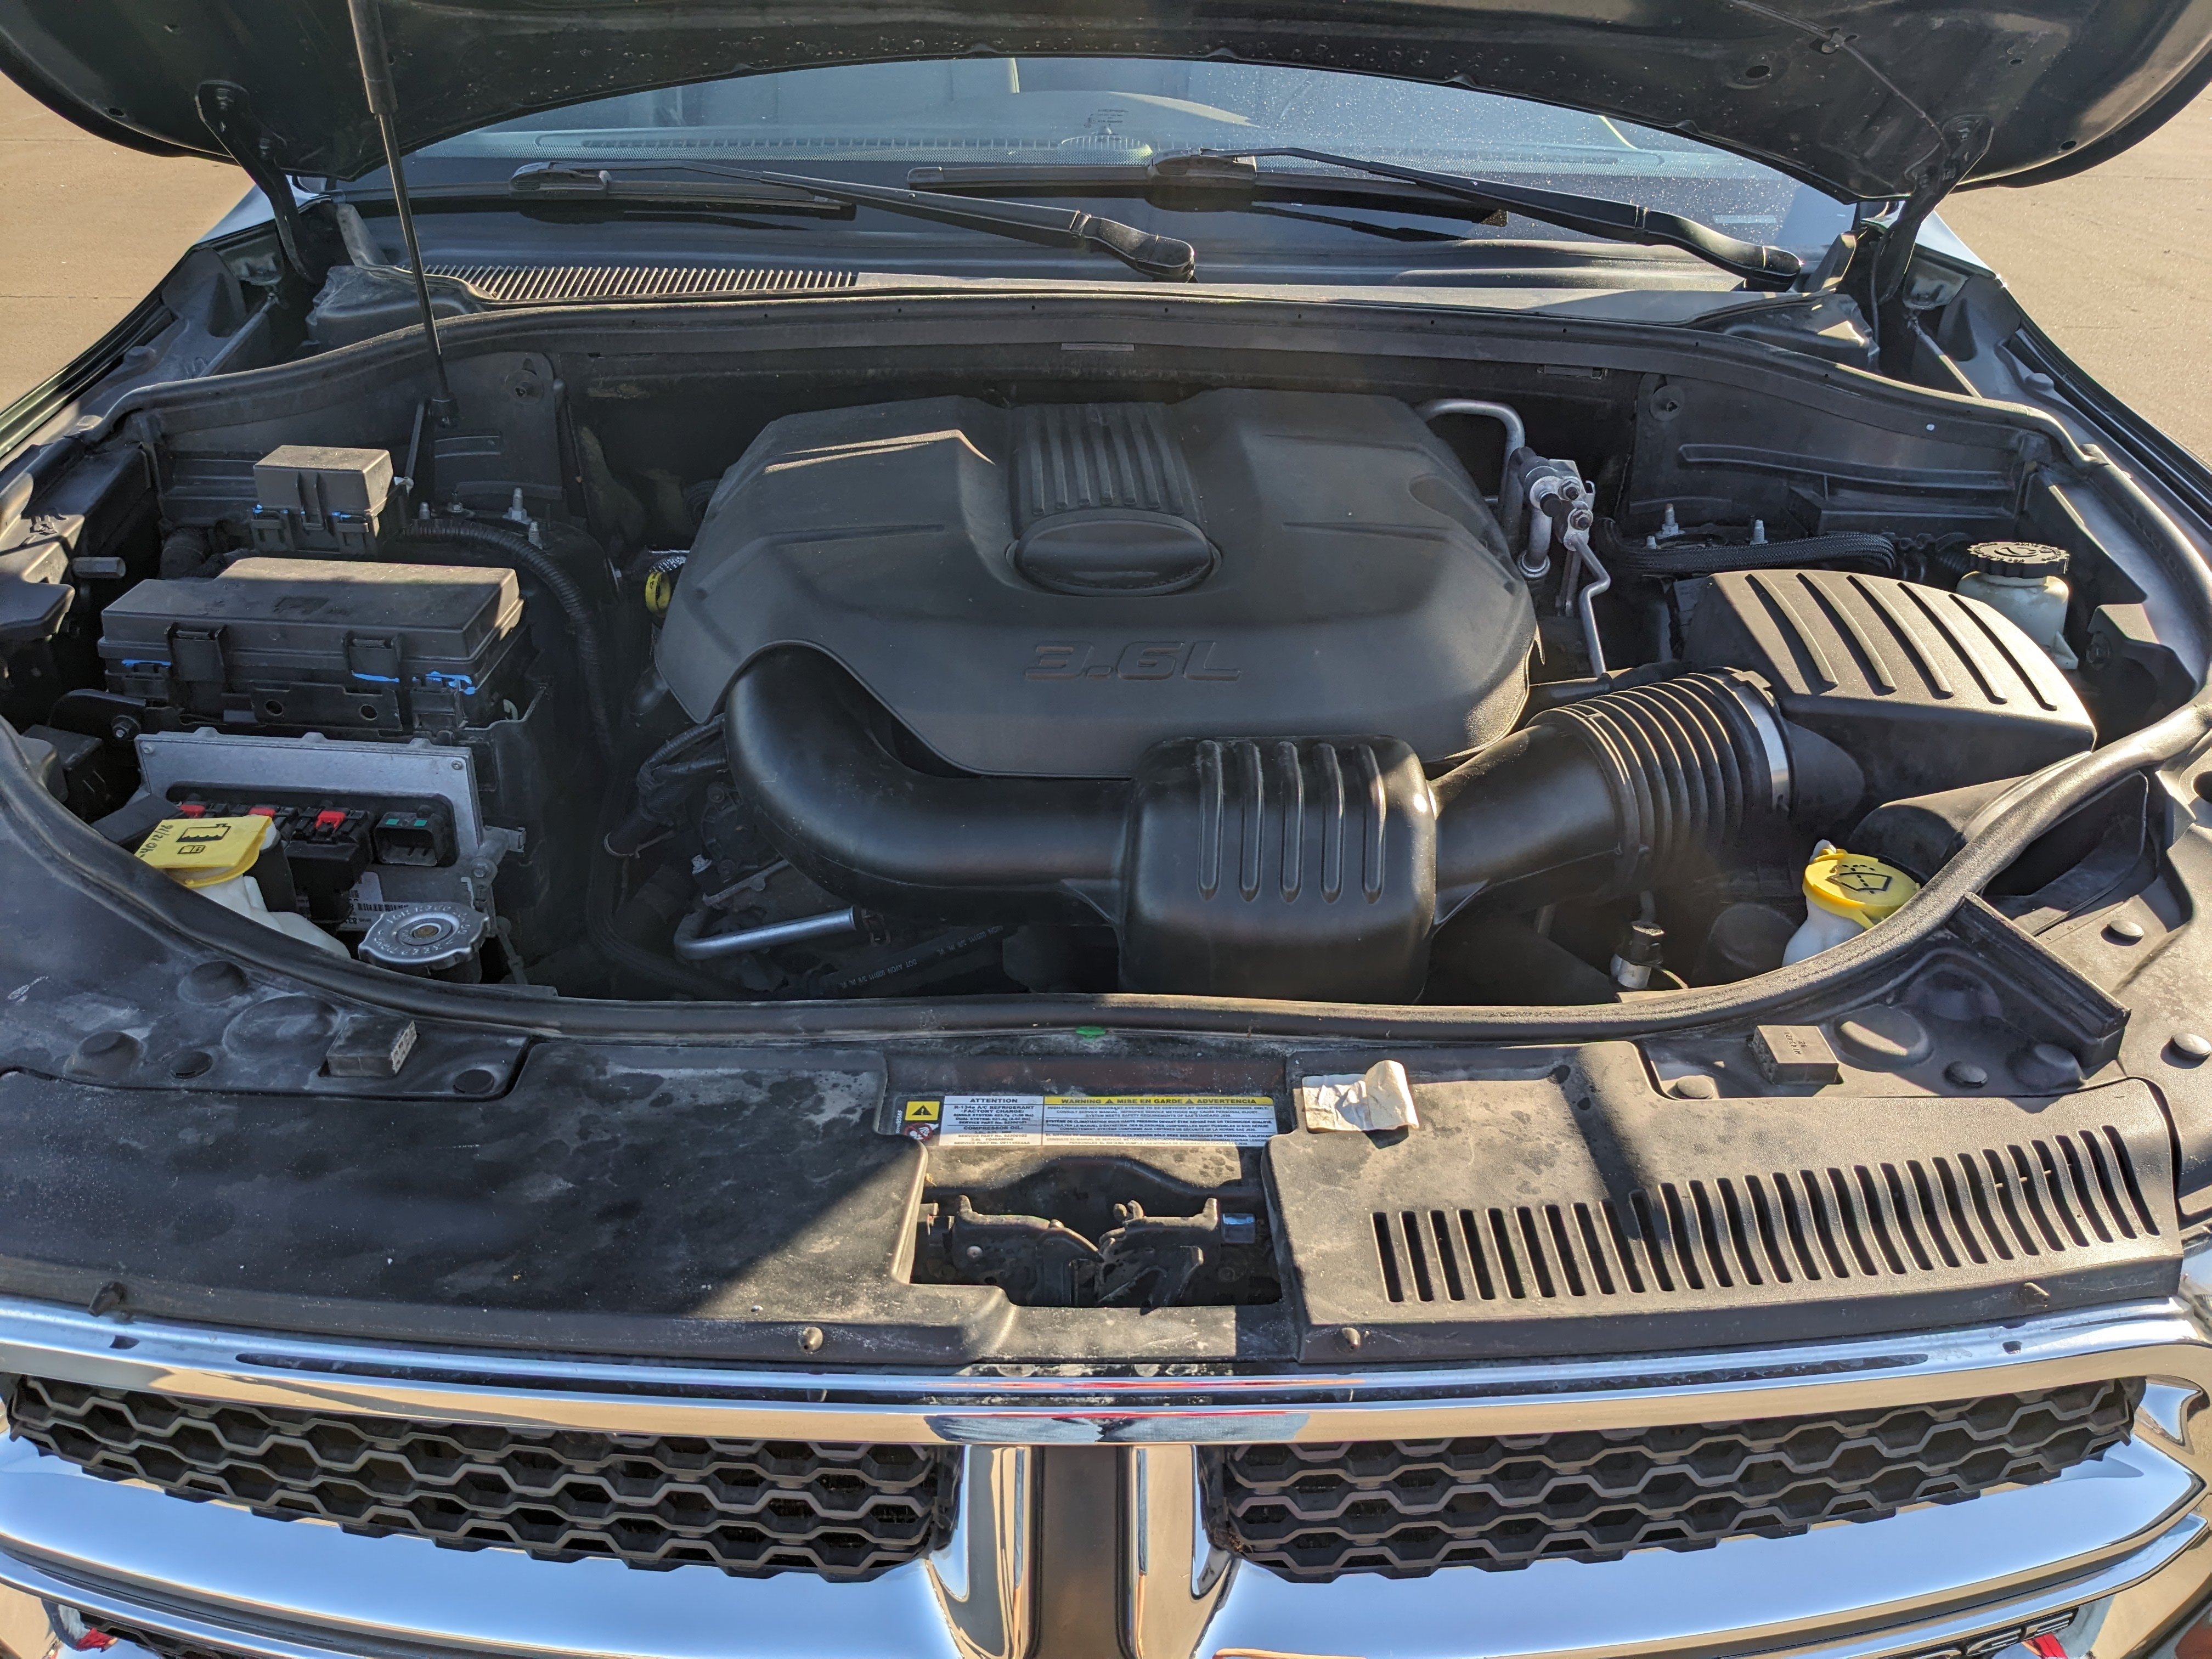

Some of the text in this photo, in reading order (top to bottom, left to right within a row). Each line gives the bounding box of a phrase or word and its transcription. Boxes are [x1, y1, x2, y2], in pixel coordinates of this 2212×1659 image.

[1025, 641, 1242, 681] 3.6L
[887, 963, 902, 974] AVON
[906, 958, 918, 968] DOT
